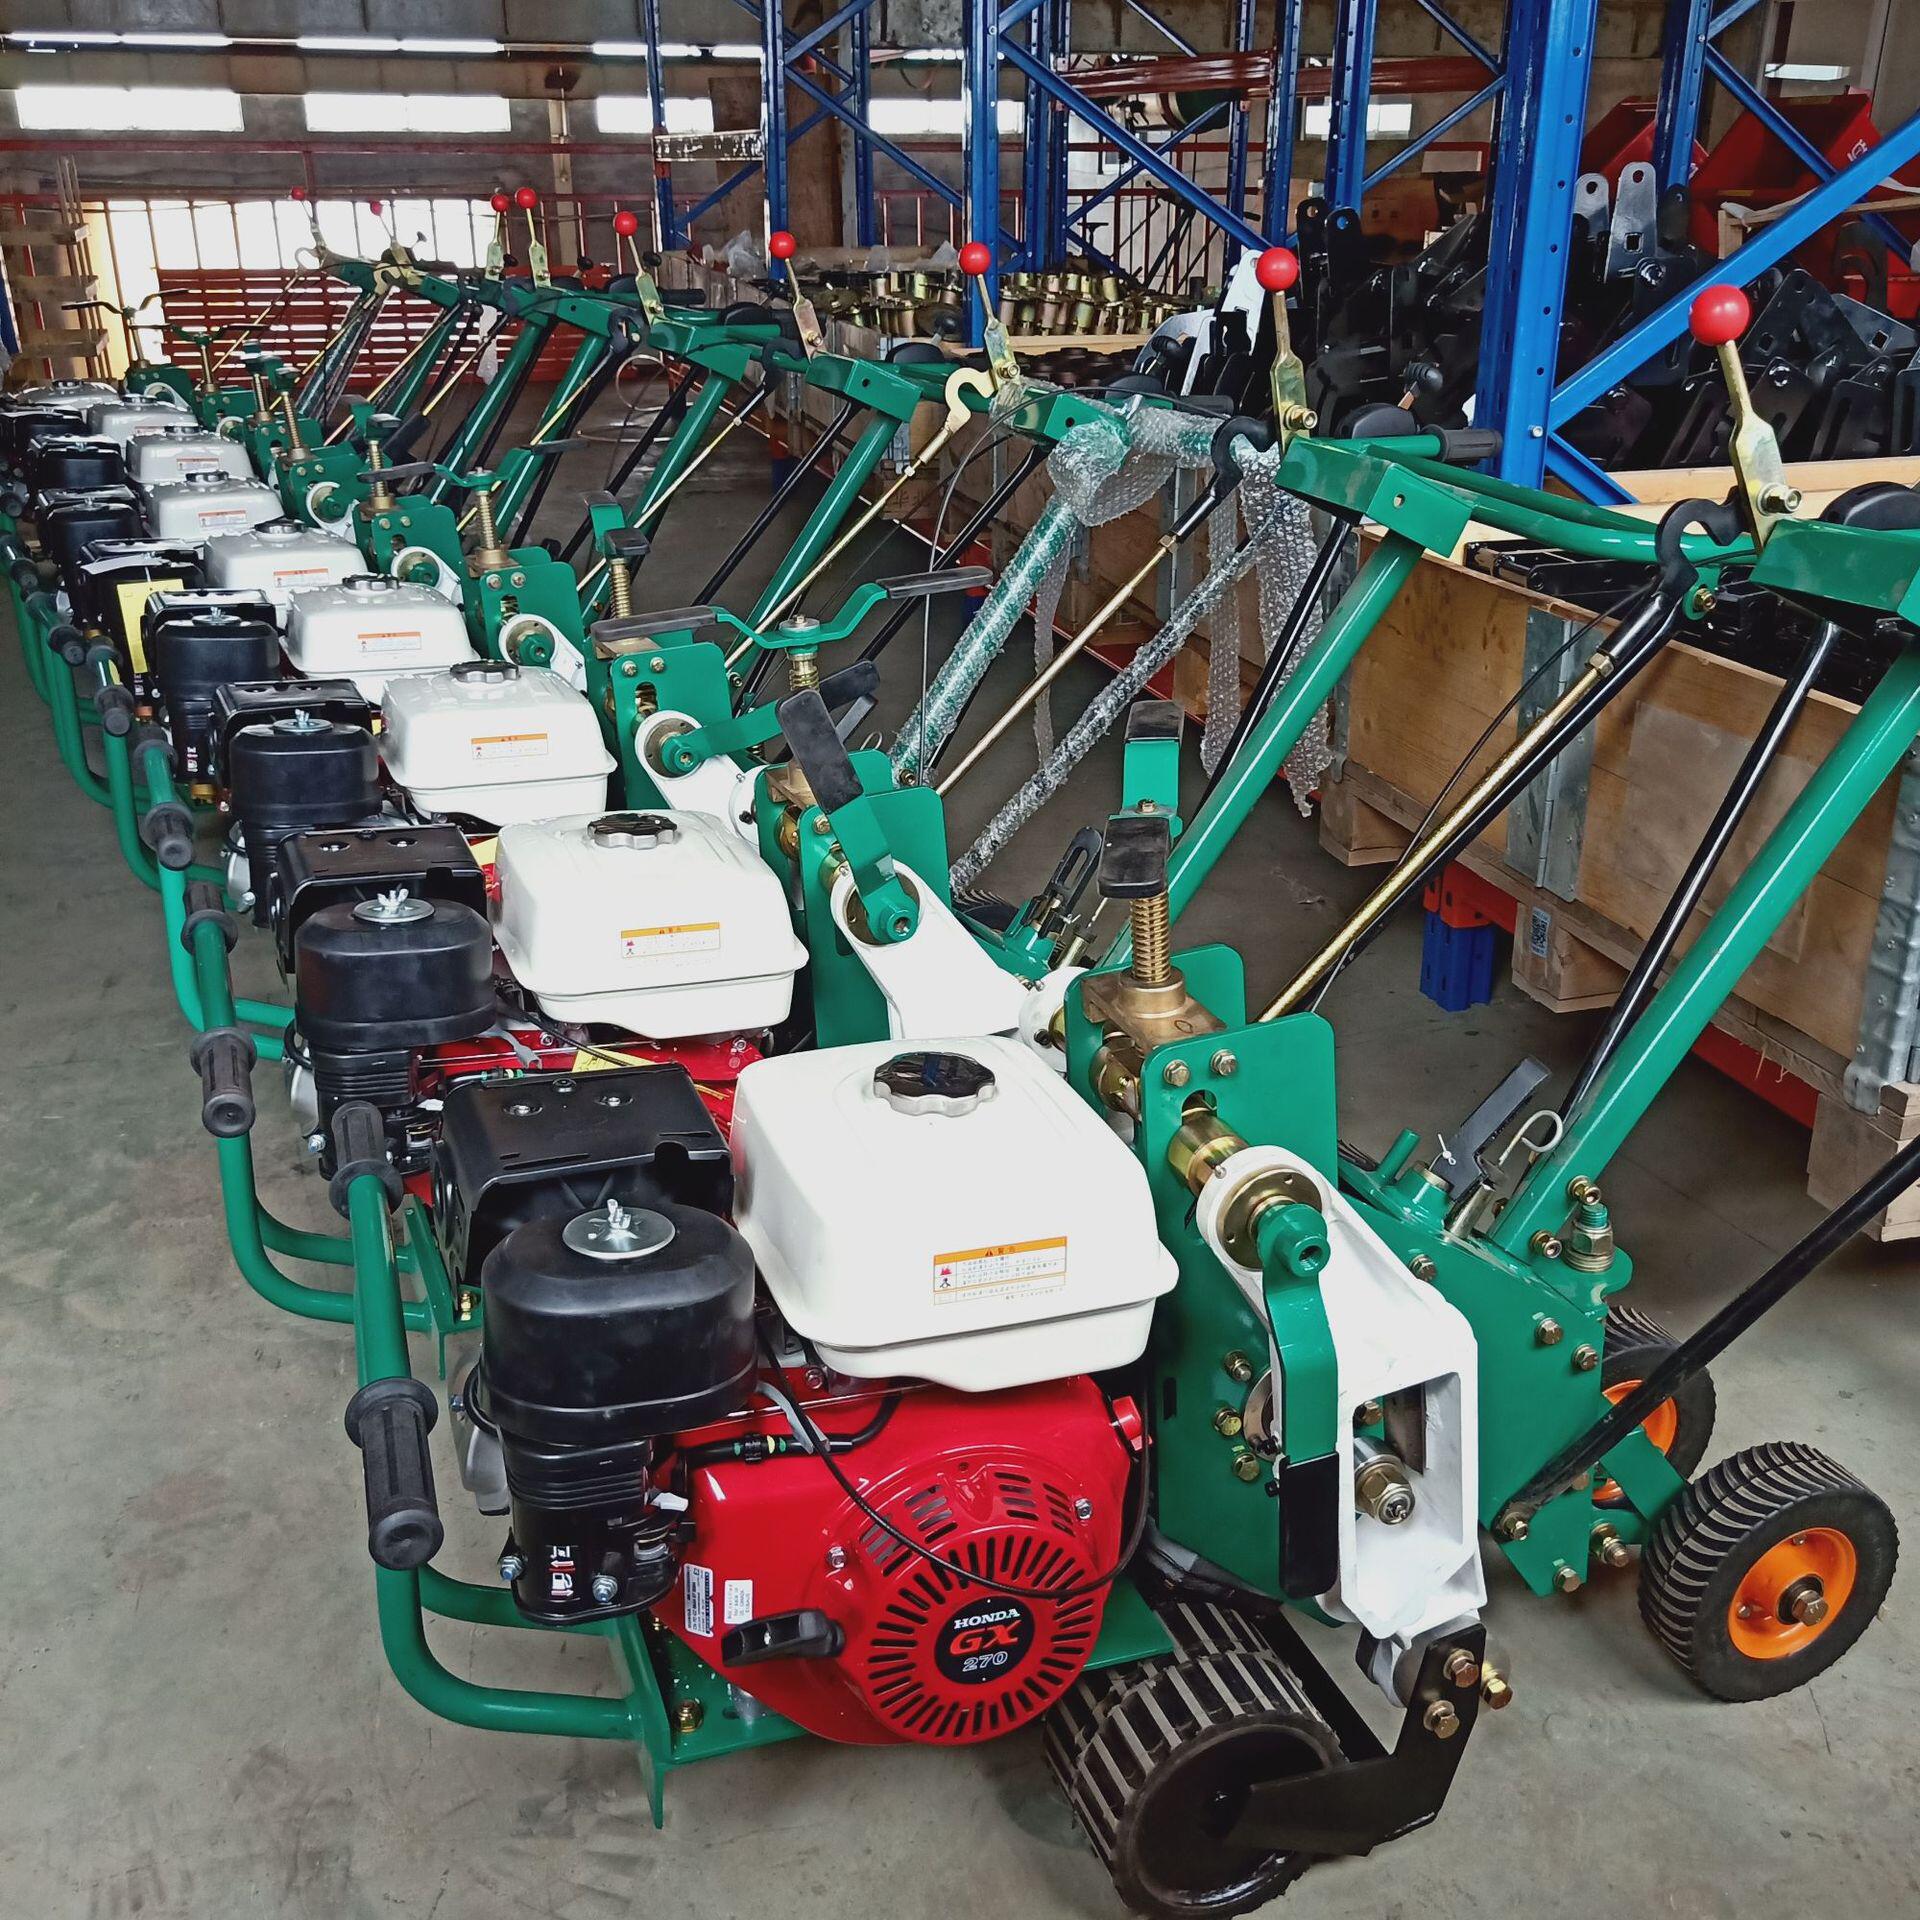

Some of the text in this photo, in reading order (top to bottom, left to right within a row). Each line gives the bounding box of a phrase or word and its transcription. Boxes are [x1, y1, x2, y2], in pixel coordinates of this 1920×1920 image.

[954, 1608, 1020, 1629] HONDA
[950, 1620, 1021, 1655] GX
[962, 1652, 1008, 1672] 270
